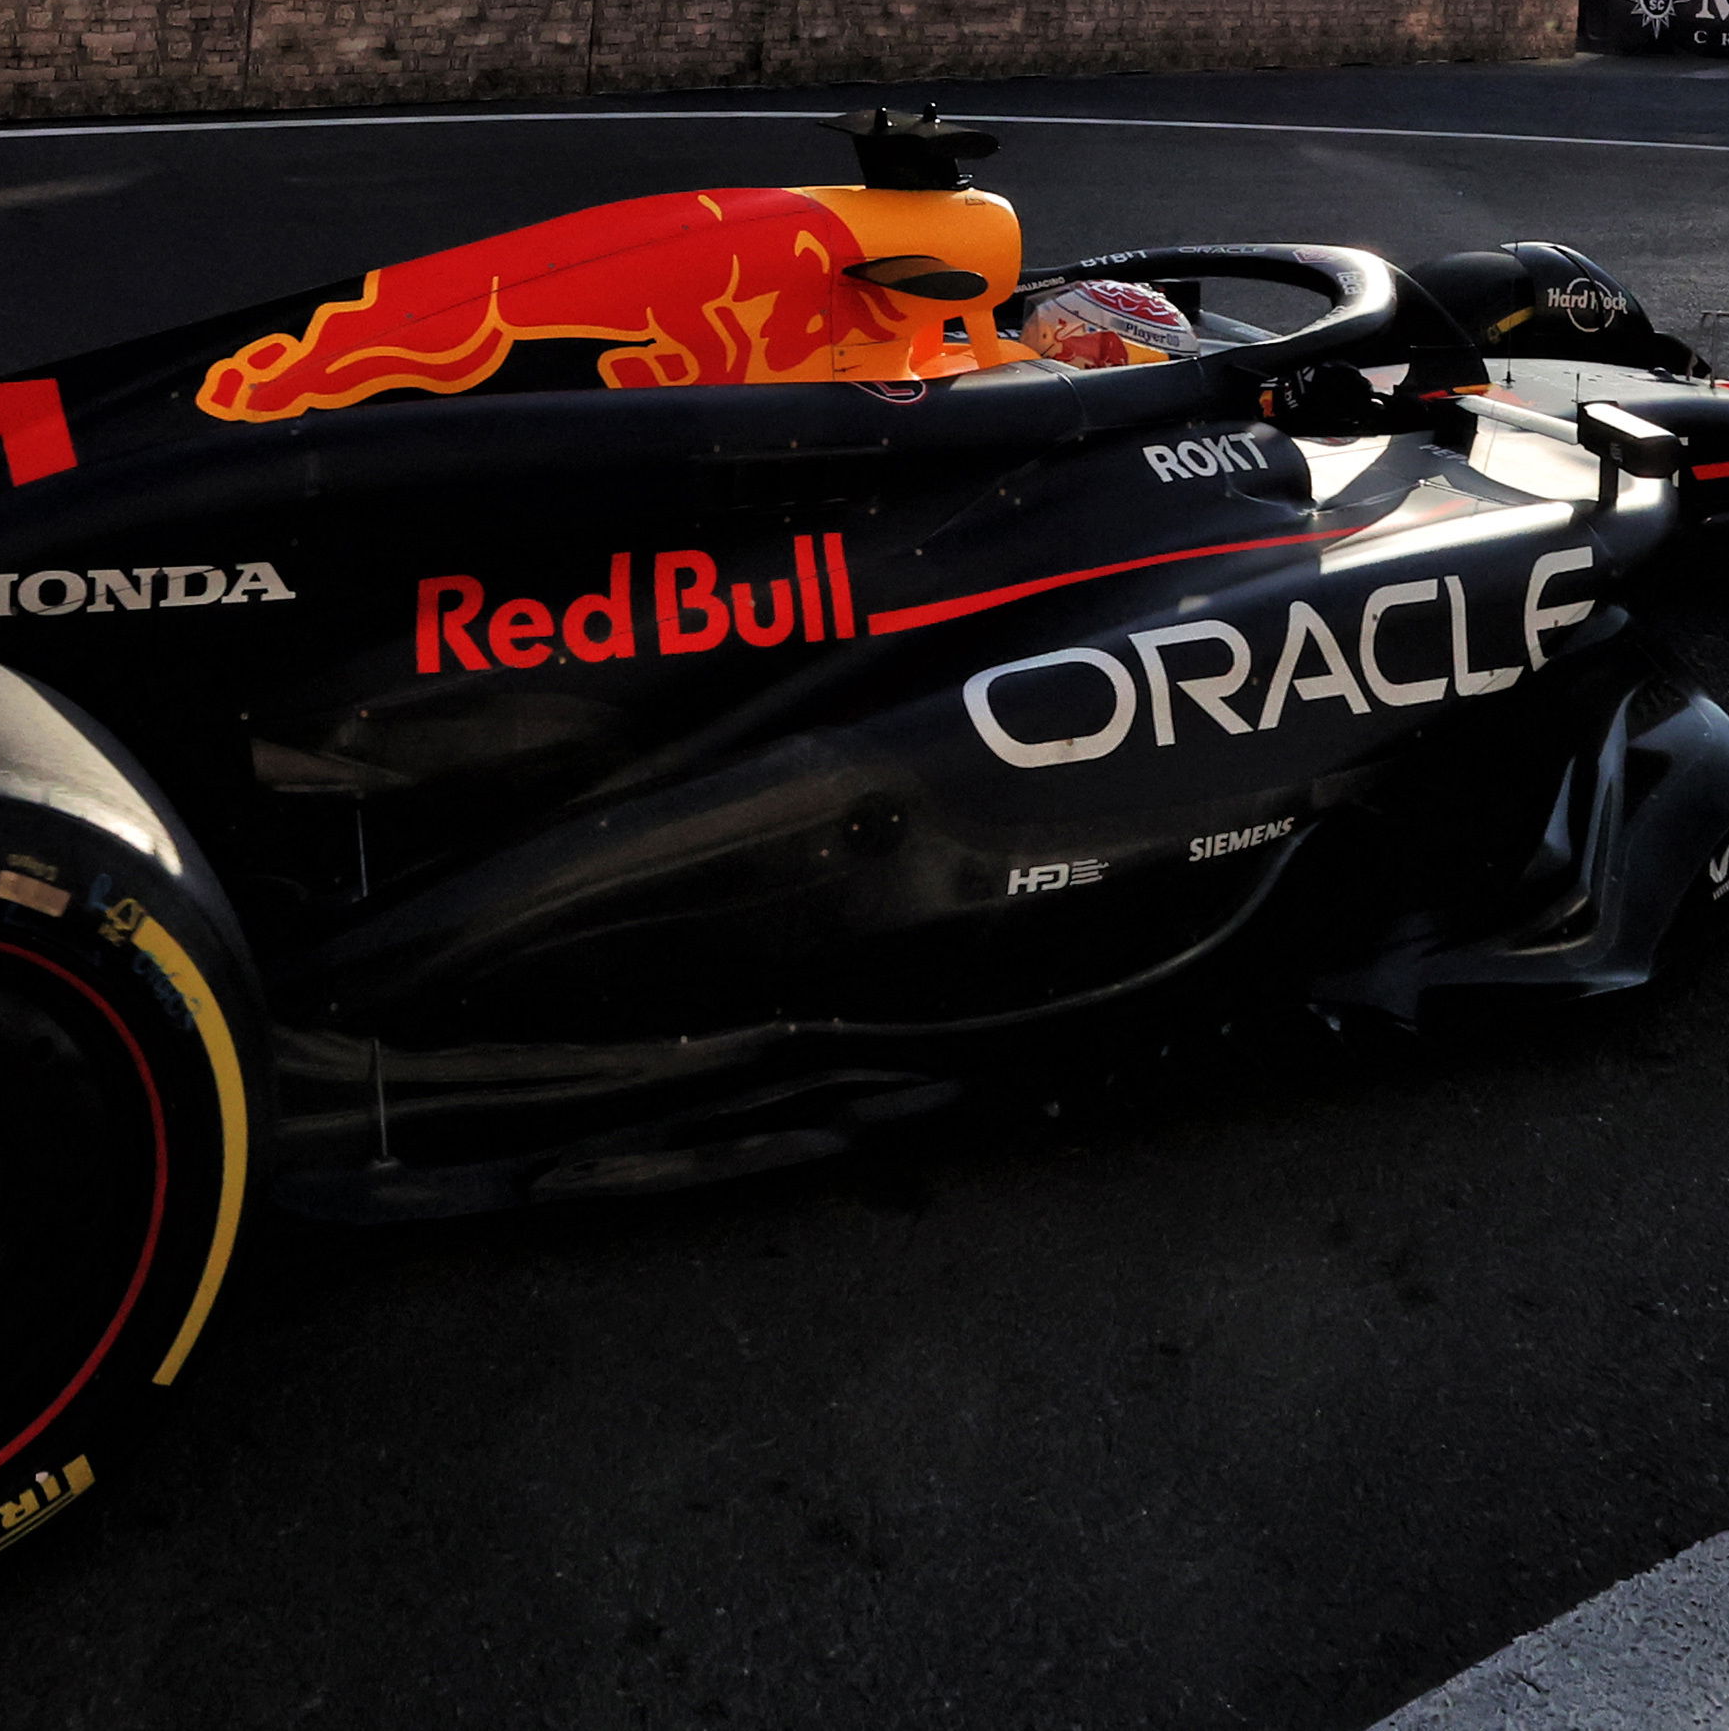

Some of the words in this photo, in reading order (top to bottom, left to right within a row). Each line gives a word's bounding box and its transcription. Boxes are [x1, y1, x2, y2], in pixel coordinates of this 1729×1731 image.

[1080, 249, 1148, 268] BYBIT
[1547, 288, 1588, 309] Hard
[1142, 432, 1269, 483] ROKT
[416, 552, 636, 673] Red
[654, 532, 855, 656] Bull
[962, 545, 1596, 769] ORACLE
[1189, 817, 1295, 862] SIEMENS
